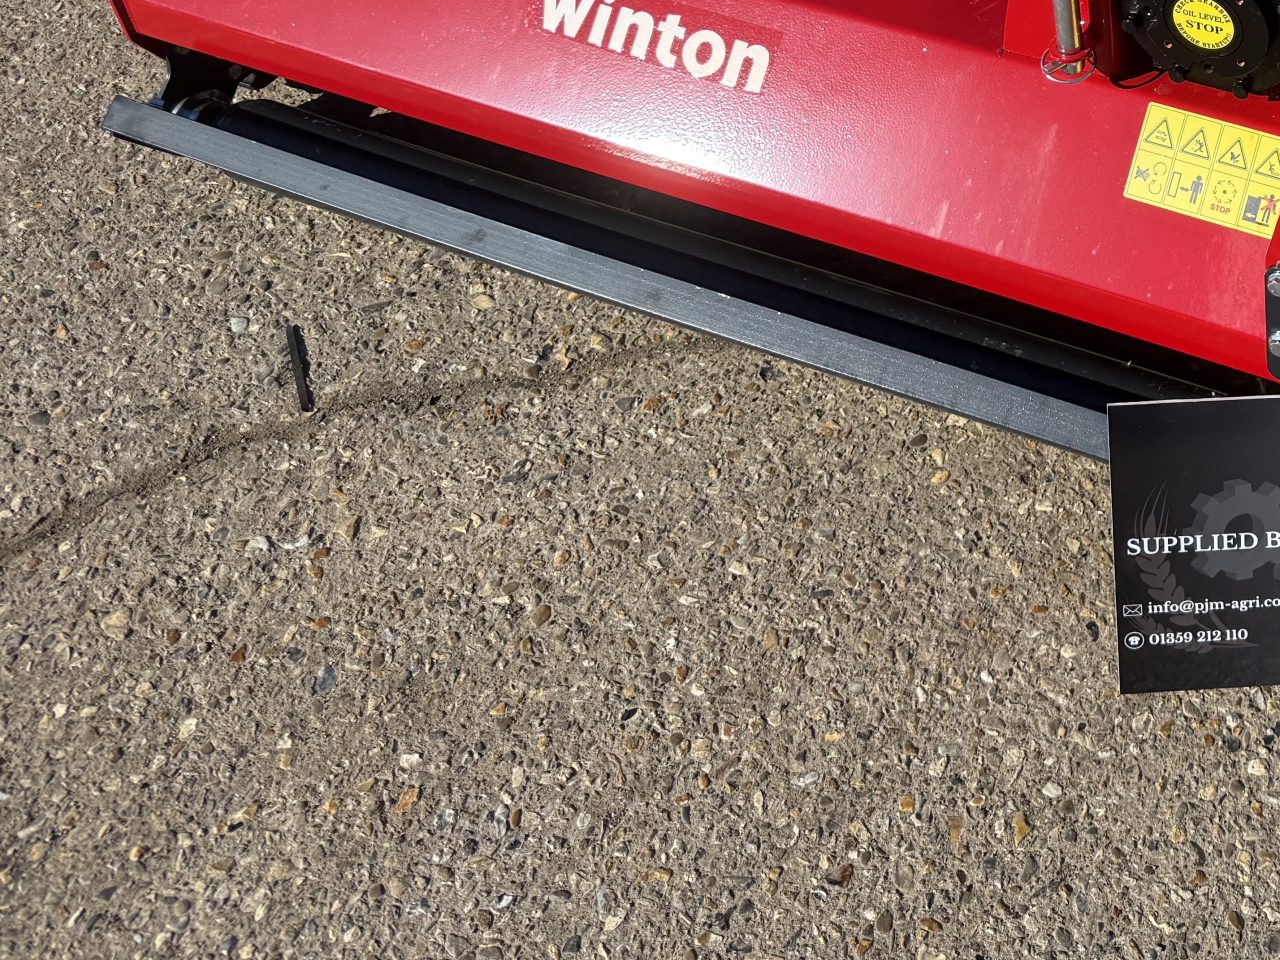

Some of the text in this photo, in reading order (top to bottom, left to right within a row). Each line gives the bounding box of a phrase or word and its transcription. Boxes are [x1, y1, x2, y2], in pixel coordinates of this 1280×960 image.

[1182, 8, 1224, 24] OIL LEVEL
[1185, 19, 1223, 34] STOP
[1210, 203, 1230, 214] STOP
[1127, 532, 1259, 556] SUPPLIED
[1149, 628, 1249, 645] 01359 212 110
